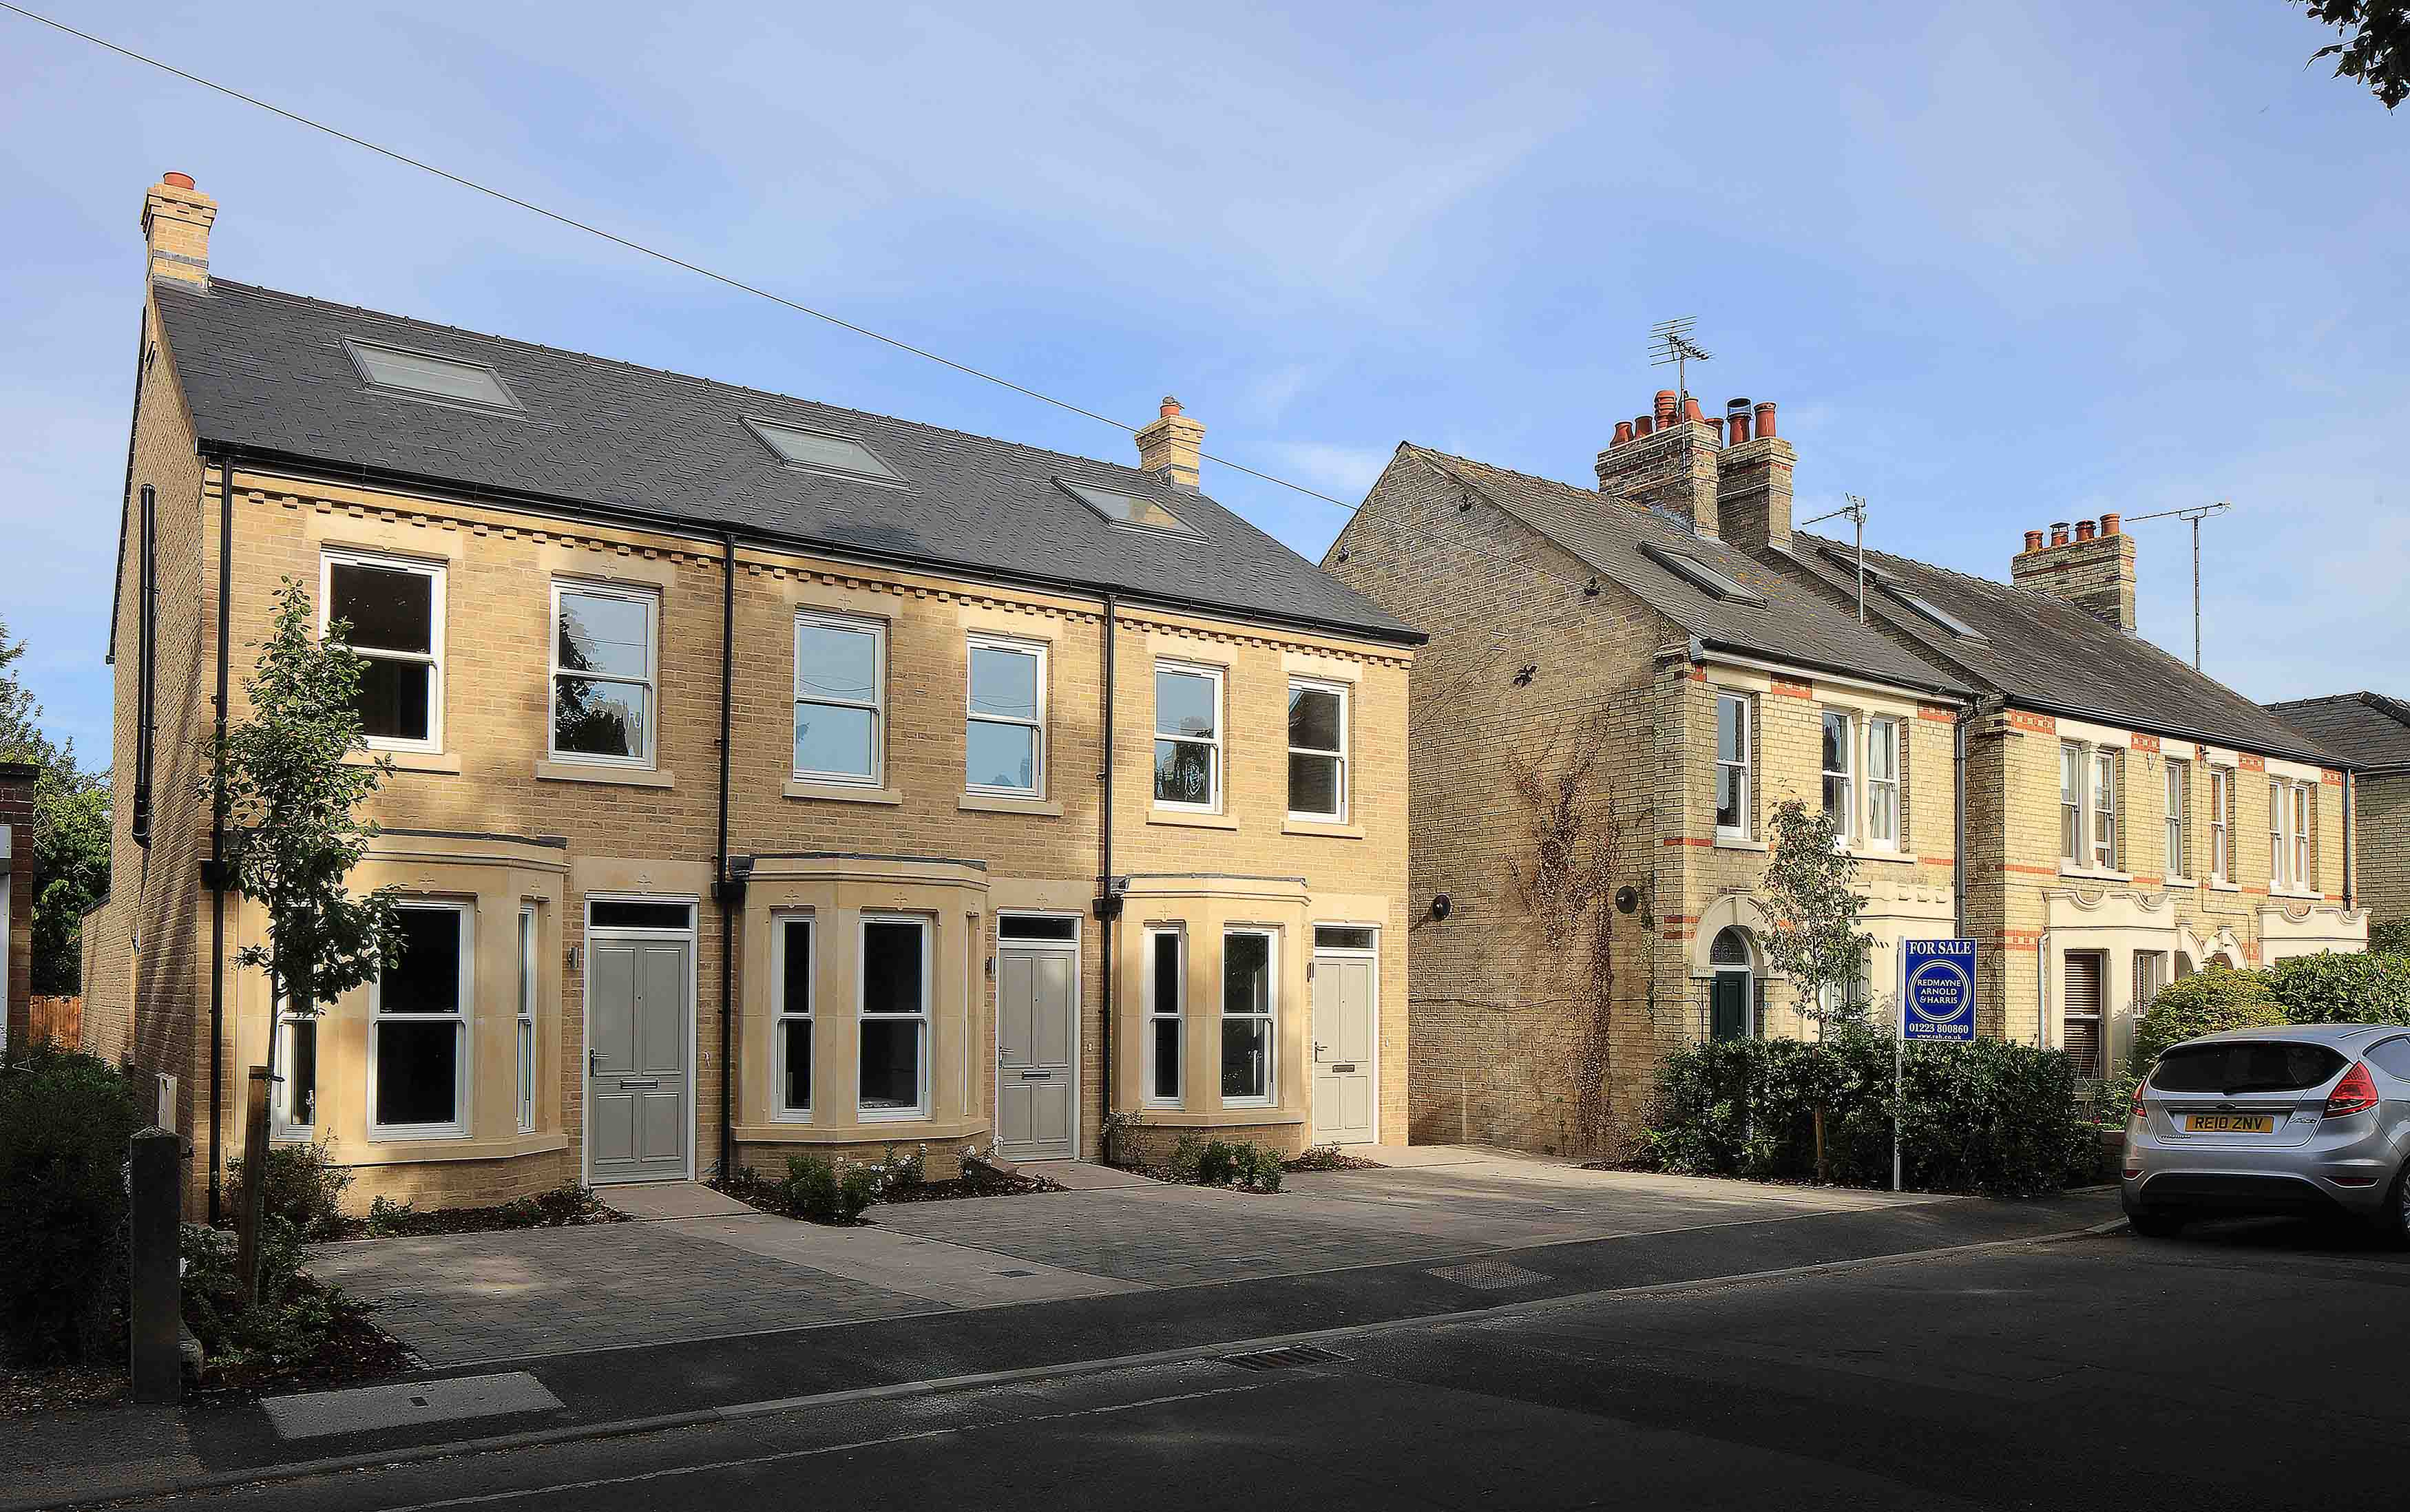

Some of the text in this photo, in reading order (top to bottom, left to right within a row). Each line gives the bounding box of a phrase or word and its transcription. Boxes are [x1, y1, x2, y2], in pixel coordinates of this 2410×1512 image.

[1909, 942, 1971, 954] FOR SALE
[1909, 1022, 1969, 1033] 01223 800860
[2194, 1117, 2263, 1130] RE10 ZNV
